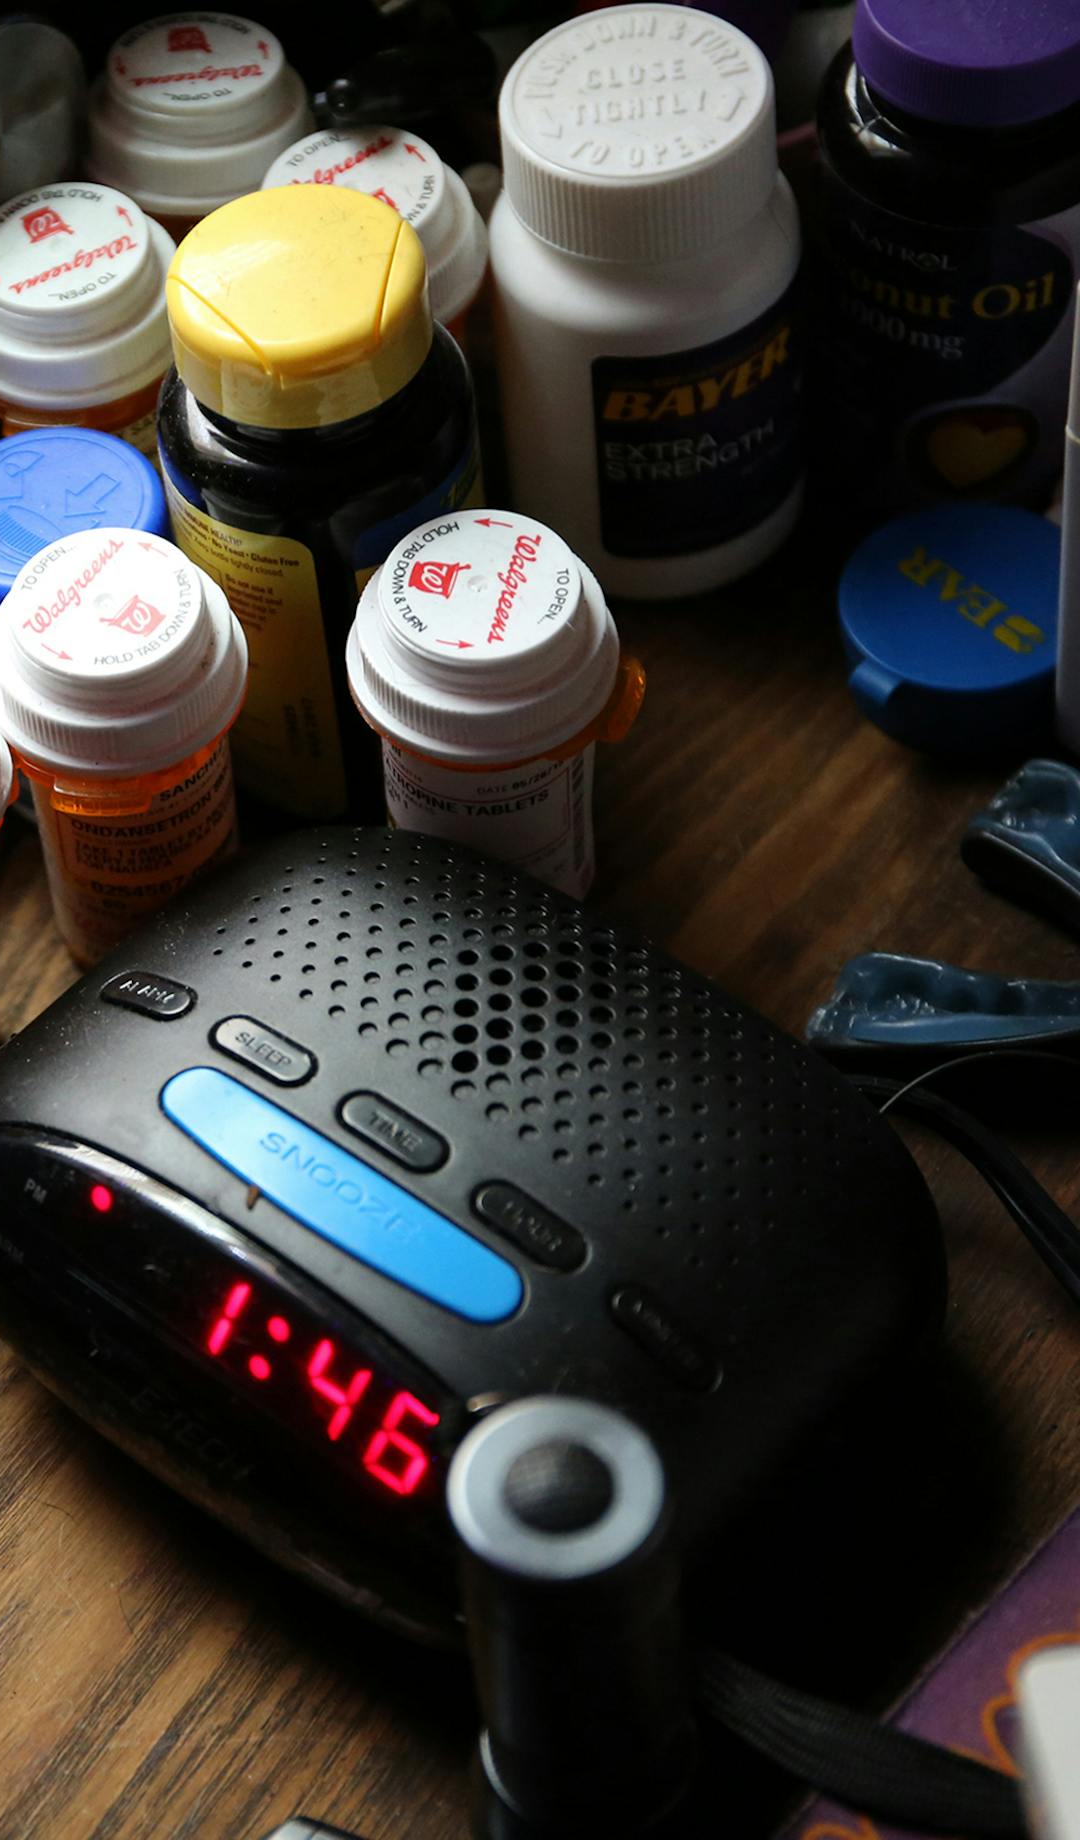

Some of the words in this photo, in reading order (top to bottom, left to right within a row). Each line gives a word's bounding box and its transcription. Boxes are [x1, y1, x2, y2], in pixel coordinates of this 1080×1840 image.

[576, 15, 657, 51] DOWN
[128, 63, 264, 87] Walgreens
[586, 58, 687, 90] CLOSE
[214, 88, 234, 98] TO
[572, 89, 707, 126] TIGHTLY
[285, 155, 304, 168] TO
[571, 140, 611, 165] TO
[66, 188, 105, 203] HOLD
[420, 174, 436, 201] TURN
[8, 235, 138, 294] Walgreens
[98, 271, 118, 285] TO
[971, 271, 1056, 321] Oil
[908, 330, 967, 360] mg
[601, 324, 792, 423] BAYER
[604, 432, 718, 462] EXTRA
[605, 416, 775, 480] STRENGTH
[421, 520, 460, 544] HOLD
[250, 552, 279, 565] Gluten
[280, 557, 300, 567] Free
[402, 540, 426, 560] TAB
[20, 574, 39, 592] TO
[21, 539, 125, 635] Walgreens
[173, 568, 192, 600] TURN
[391, 560, 410, 596] DOWN
[486, 533, 542, 644] Walgreens
[556, 567, 571, 585] TO
[183, 599, 192, 609] &
[392, 595, 407, 604] &
[158, 608, 189, 642] DOWN
[398, 605, 429, 633] TURN
[93, 650, 134, 666] HOLD
[136, 640, 161, 659] TAB
[70, 791, 213, 839] ONDANSETRON
[463, 788, 550, 817] TABLETS
[234, 1030, 293, 1069] SLEEP
[369, 1110, 422, 1151] TIME
[23, 1177, 48, 1204] PM
[259, 1130, 418, 1236] SNOOZE
[207, 1282, 440, 1495] 1:46
